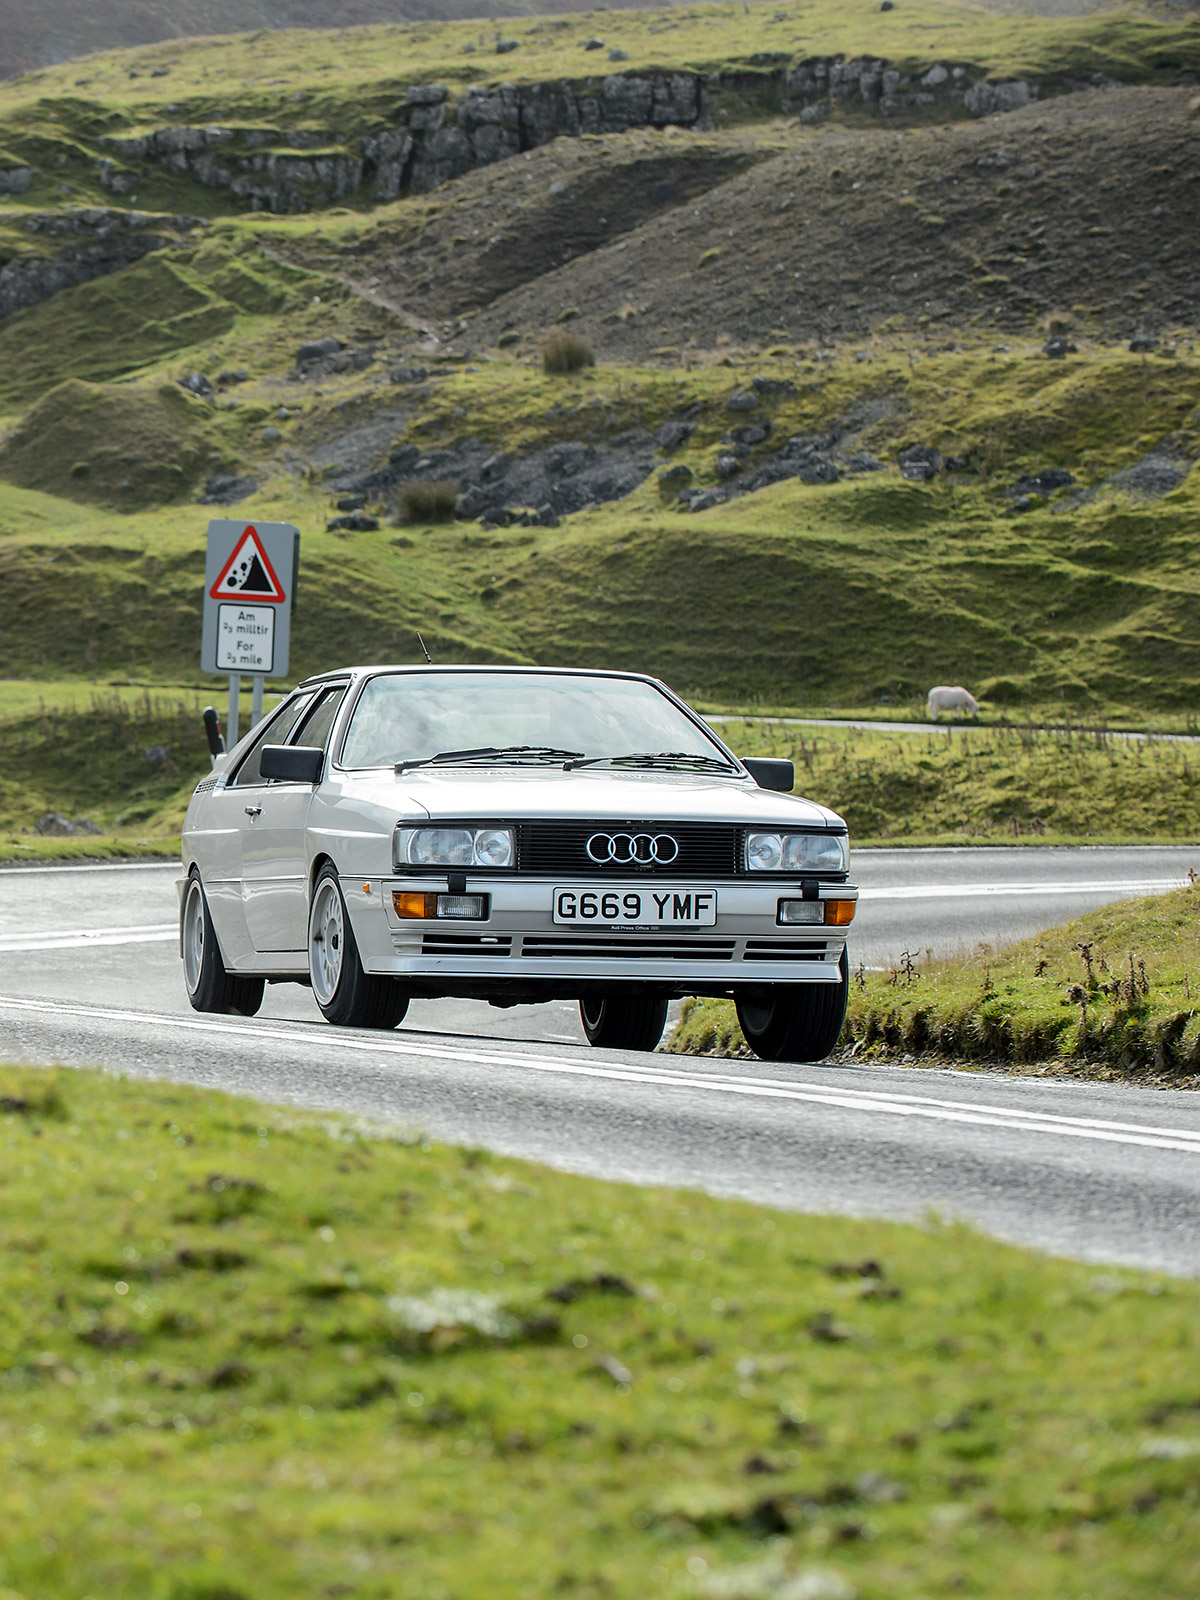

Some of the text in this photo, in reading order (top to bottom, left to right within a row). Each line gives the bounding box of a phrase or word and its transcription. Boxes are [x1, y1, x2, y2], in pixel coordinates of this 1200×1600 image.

[238, 611, 255, 621] Am
[236, 624, 269, 634] milltir
[236, 640, 254, 651] For
[240, 653, 263, 665] mile
[557, 892, 713, 920] G669 YMF
